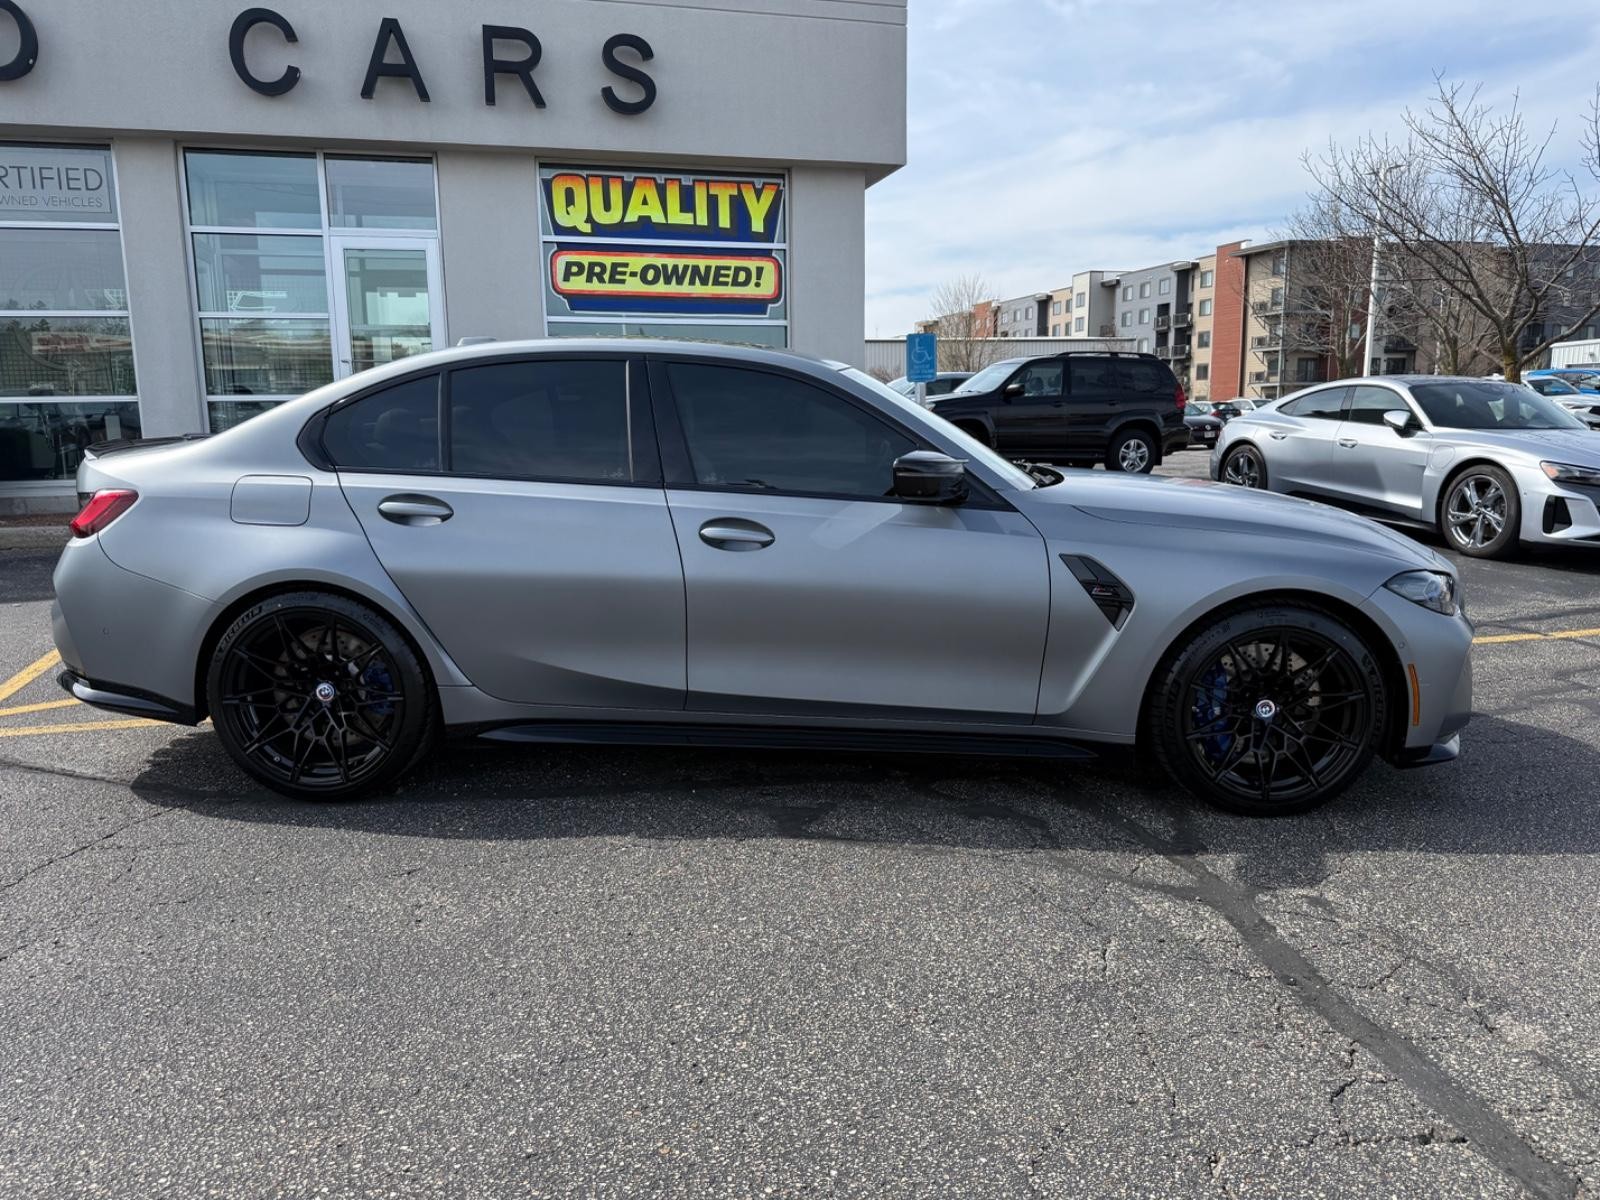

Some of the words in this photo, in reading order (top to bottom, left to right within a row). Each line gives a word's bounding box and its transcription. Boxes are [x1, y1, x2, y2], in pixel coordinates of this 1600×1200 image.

[228, 7, 657, 115] CARS
[42, 196, 103, 208] VEHICLES
[552, 174, 779, 233] QUALITY
[563, 260, 765, 288] PRE-OWNED!
